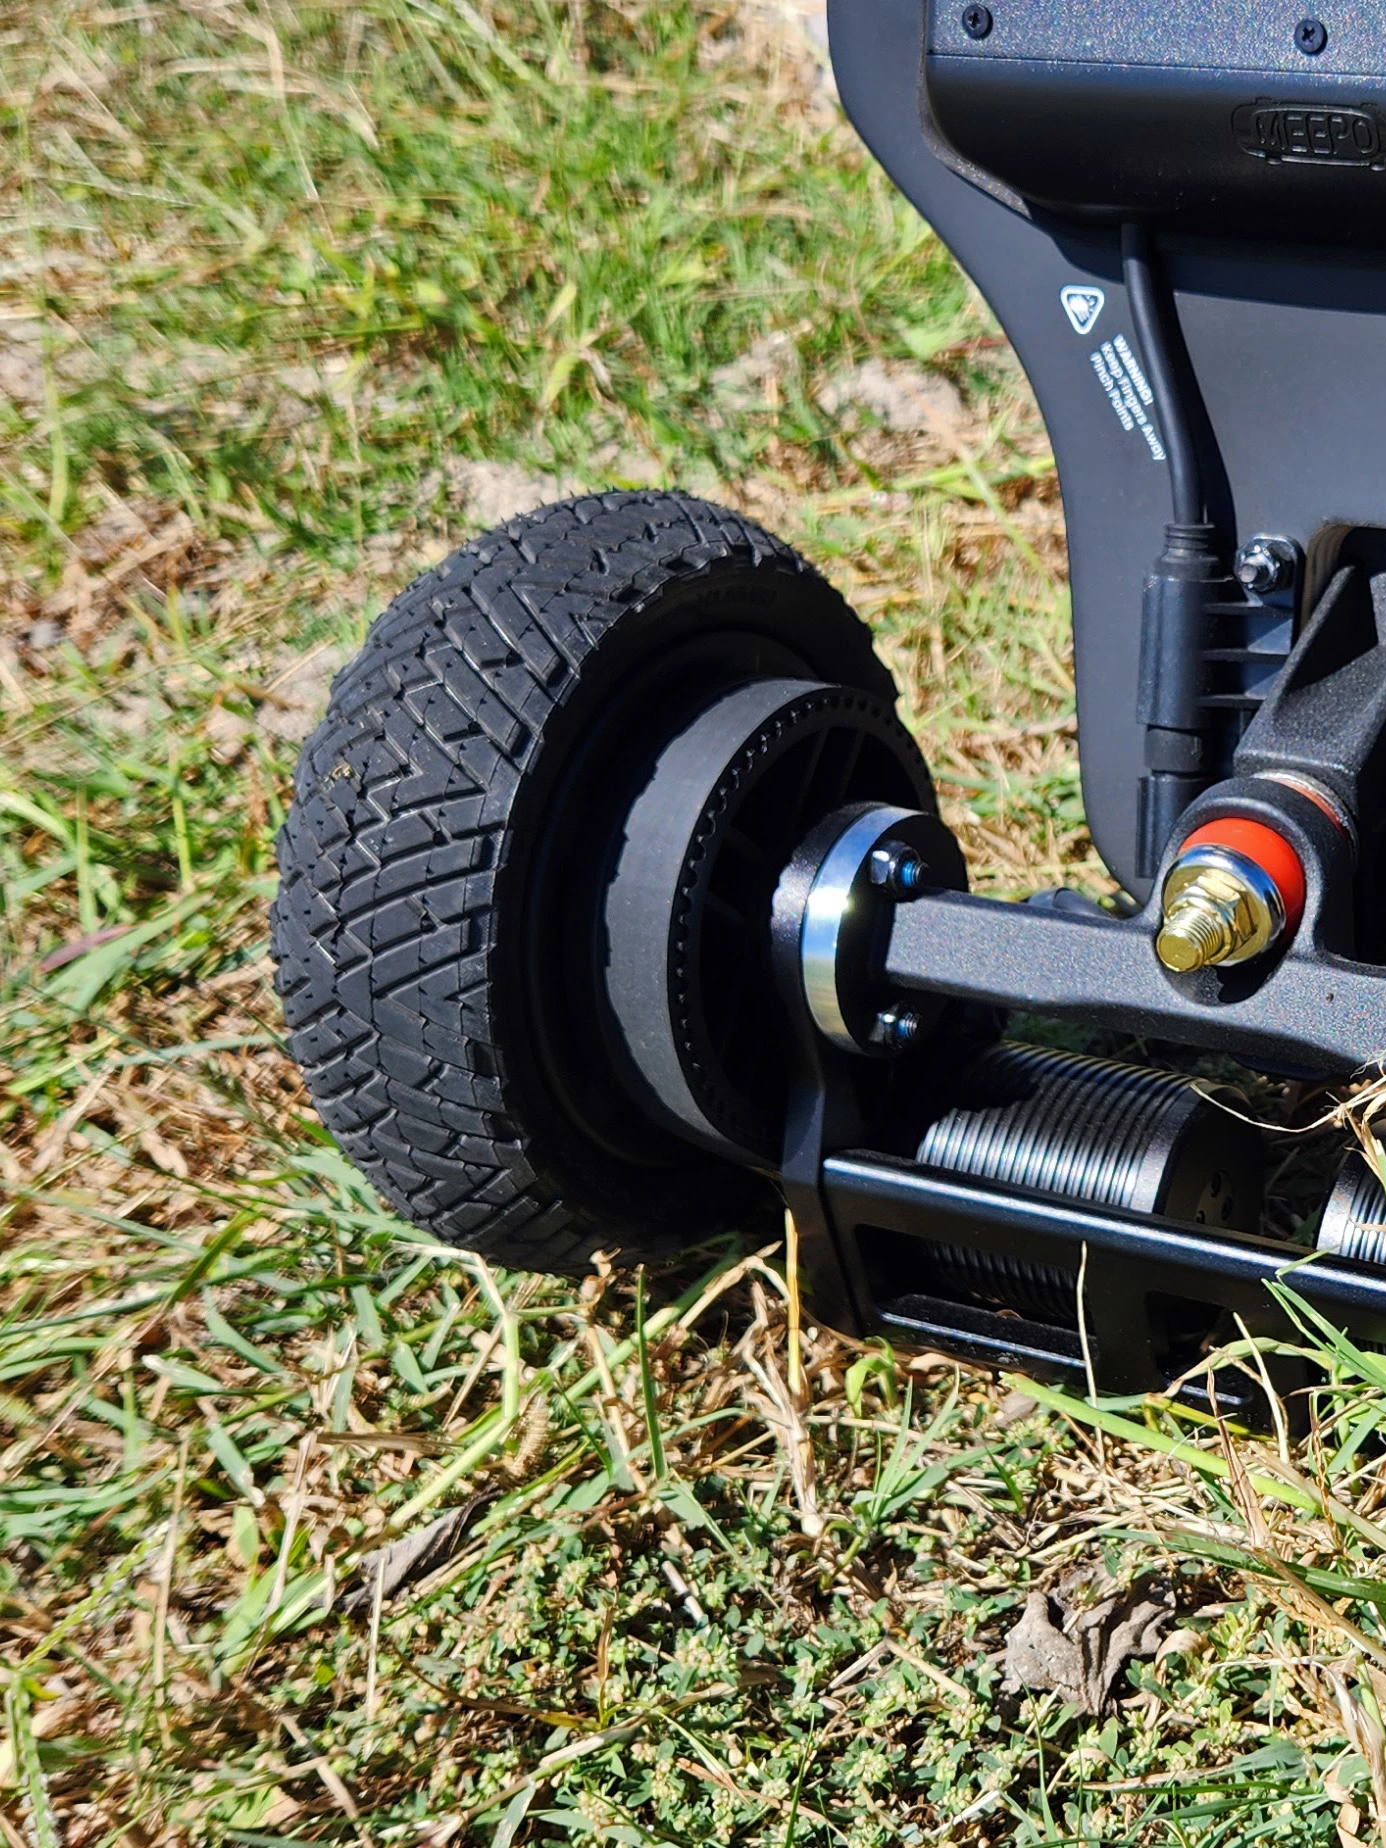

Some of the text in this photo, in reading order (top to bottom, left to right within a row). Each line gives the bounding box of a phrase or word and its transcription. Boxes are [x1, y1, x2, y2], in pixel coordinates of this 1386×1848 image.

[1252, 107, 1380, 158] MEEPO
[1089, 351, 1135, 431] Pinch Points
[1100, 341, 1167, 461] Keep Fingers Away
[1113, 333, 1154, 406] WARNING!
